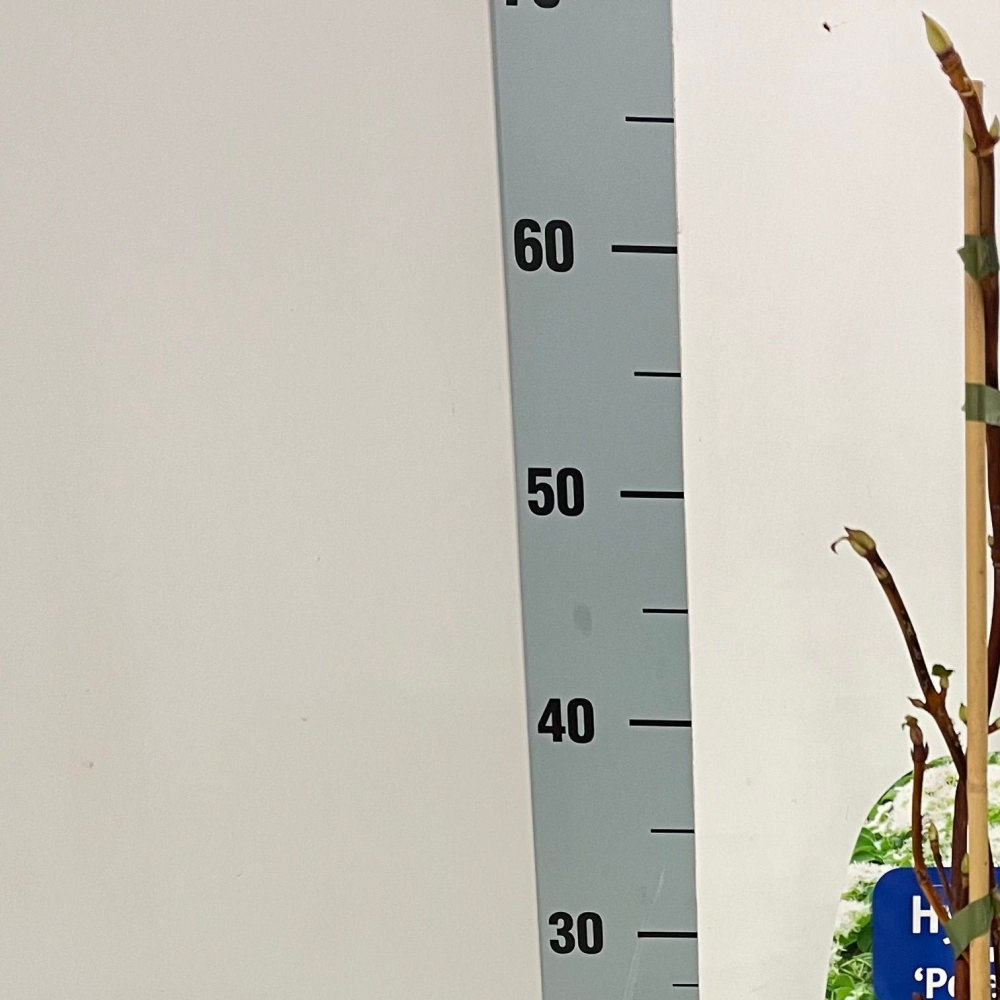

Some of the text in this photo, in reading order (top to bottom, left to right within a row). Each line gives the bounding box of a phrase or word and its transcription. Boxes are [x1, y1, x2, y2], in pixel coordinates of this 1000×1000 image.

[513, 218, 575, 273] 60
[527, 467, 585, 517] 50
[537, 697, 595, 744] 40
[548, 911, 604, 955] 30
